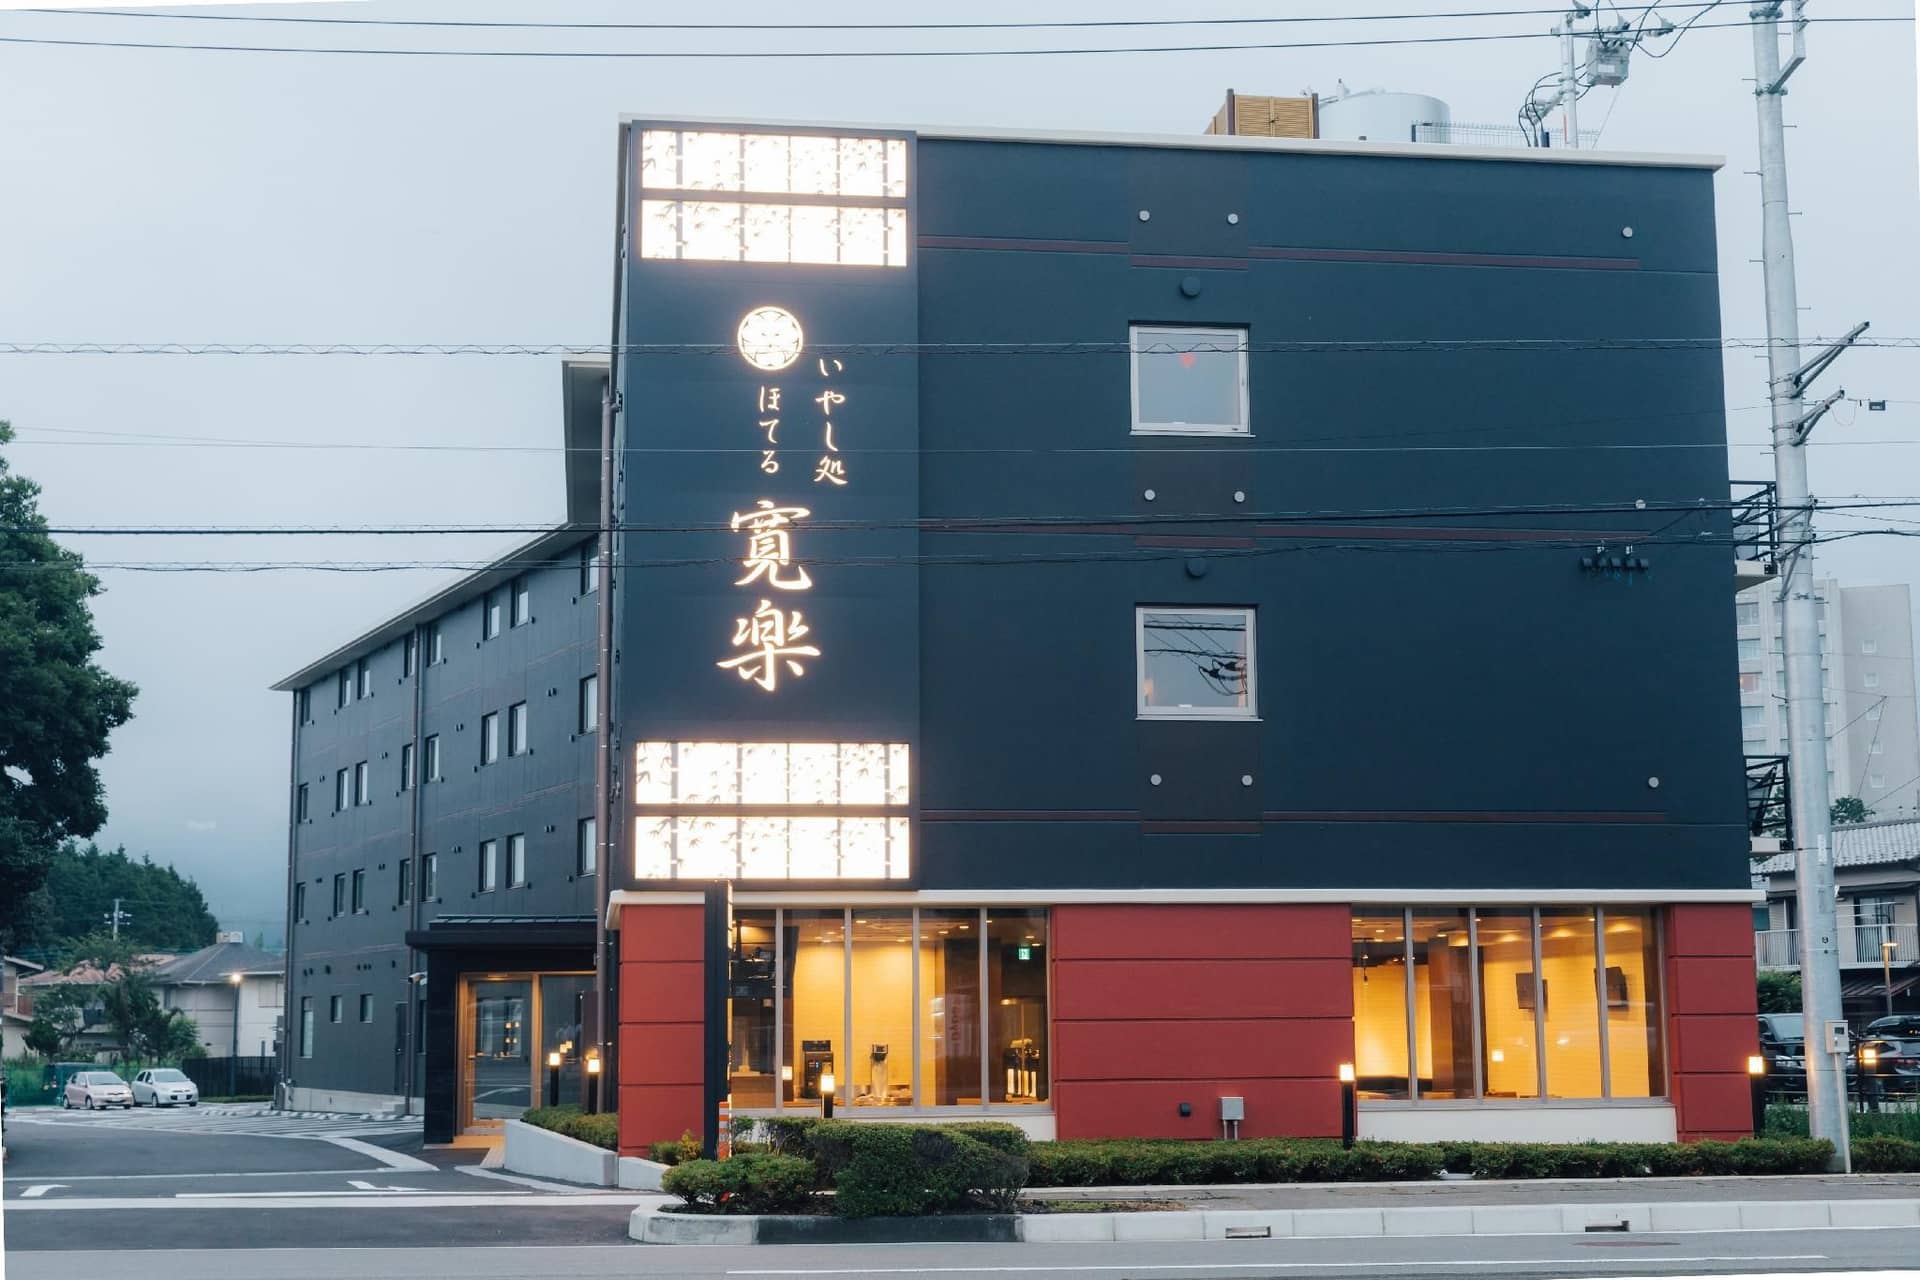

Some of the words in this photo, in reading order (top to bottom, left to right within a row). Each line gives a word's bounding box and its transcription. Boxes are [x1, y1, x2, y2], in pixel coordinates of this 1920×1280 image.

[758, 385, 781, 474] ほてる
[813, 358, 848, 485] いやし処
